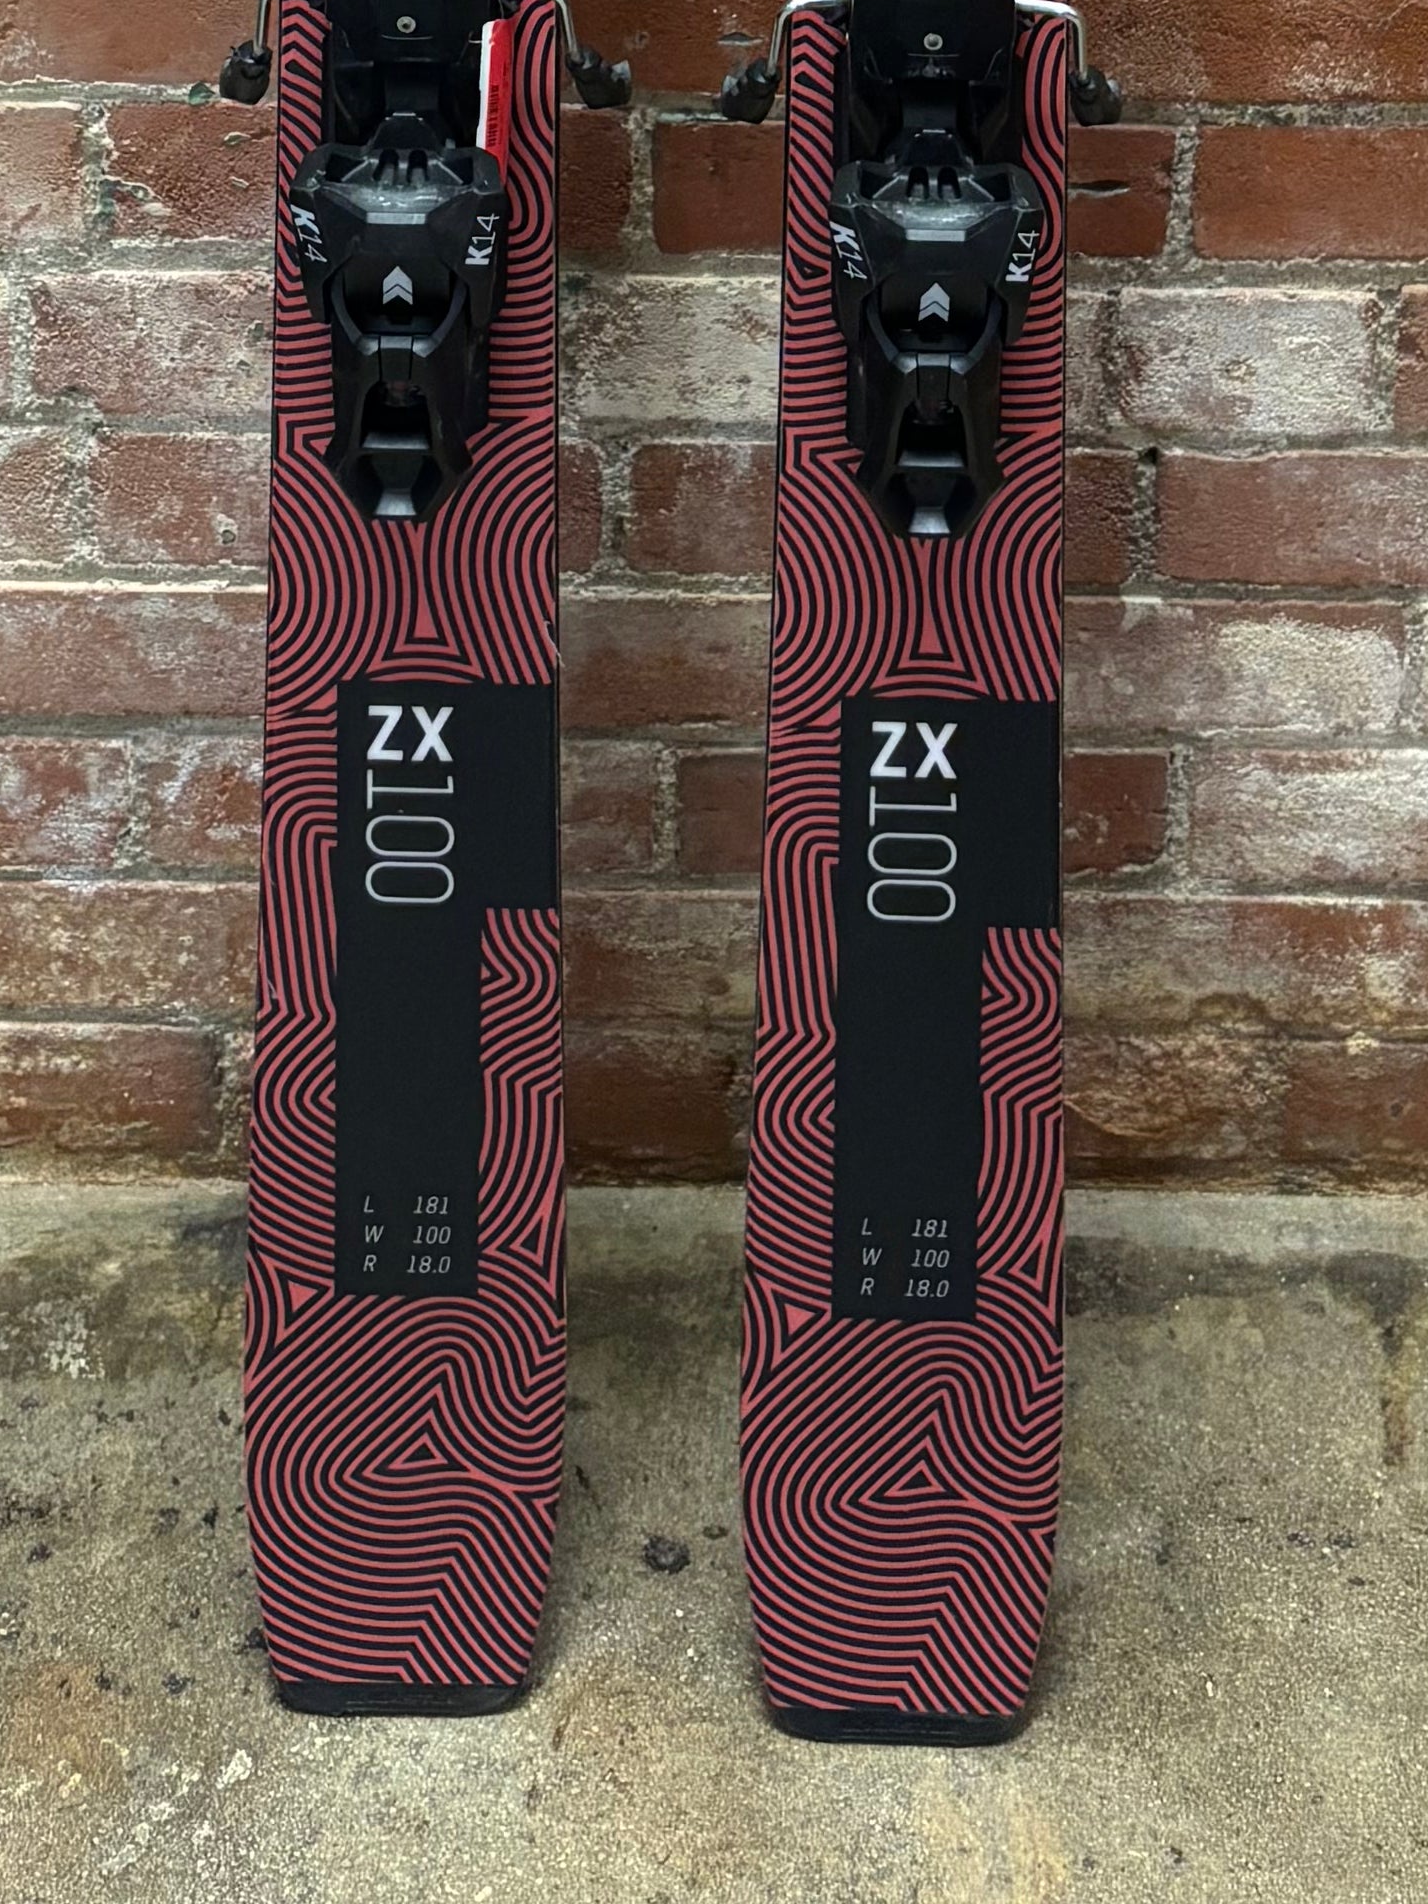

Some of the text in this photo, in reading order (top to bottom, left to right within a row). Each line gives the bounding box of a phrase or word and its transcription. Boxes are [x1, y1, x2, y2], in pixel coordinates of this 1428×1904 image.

[290, 204, 327, 263] K14
[465, 213, 500, 265] K14
[830, 221, 867, 280] K14
[1005, 230, 1040, 282] K14
[367, 705, 454, 761] ZX
[870, 721, 958, 779] ZX
[366, 769, 455, 903] 100
[867, 786, 957, 922] 100
[363, 1195, 448, 1214] L 181
[861, 1217, 948, 1238] L 181
[364, 1225, 451, 1244] W 100
[862, 1247, 950, 1268] W 100
[363, 1254, 451, 1274] R 18.0
[860, 1277, 950, 1297] R 18.0
